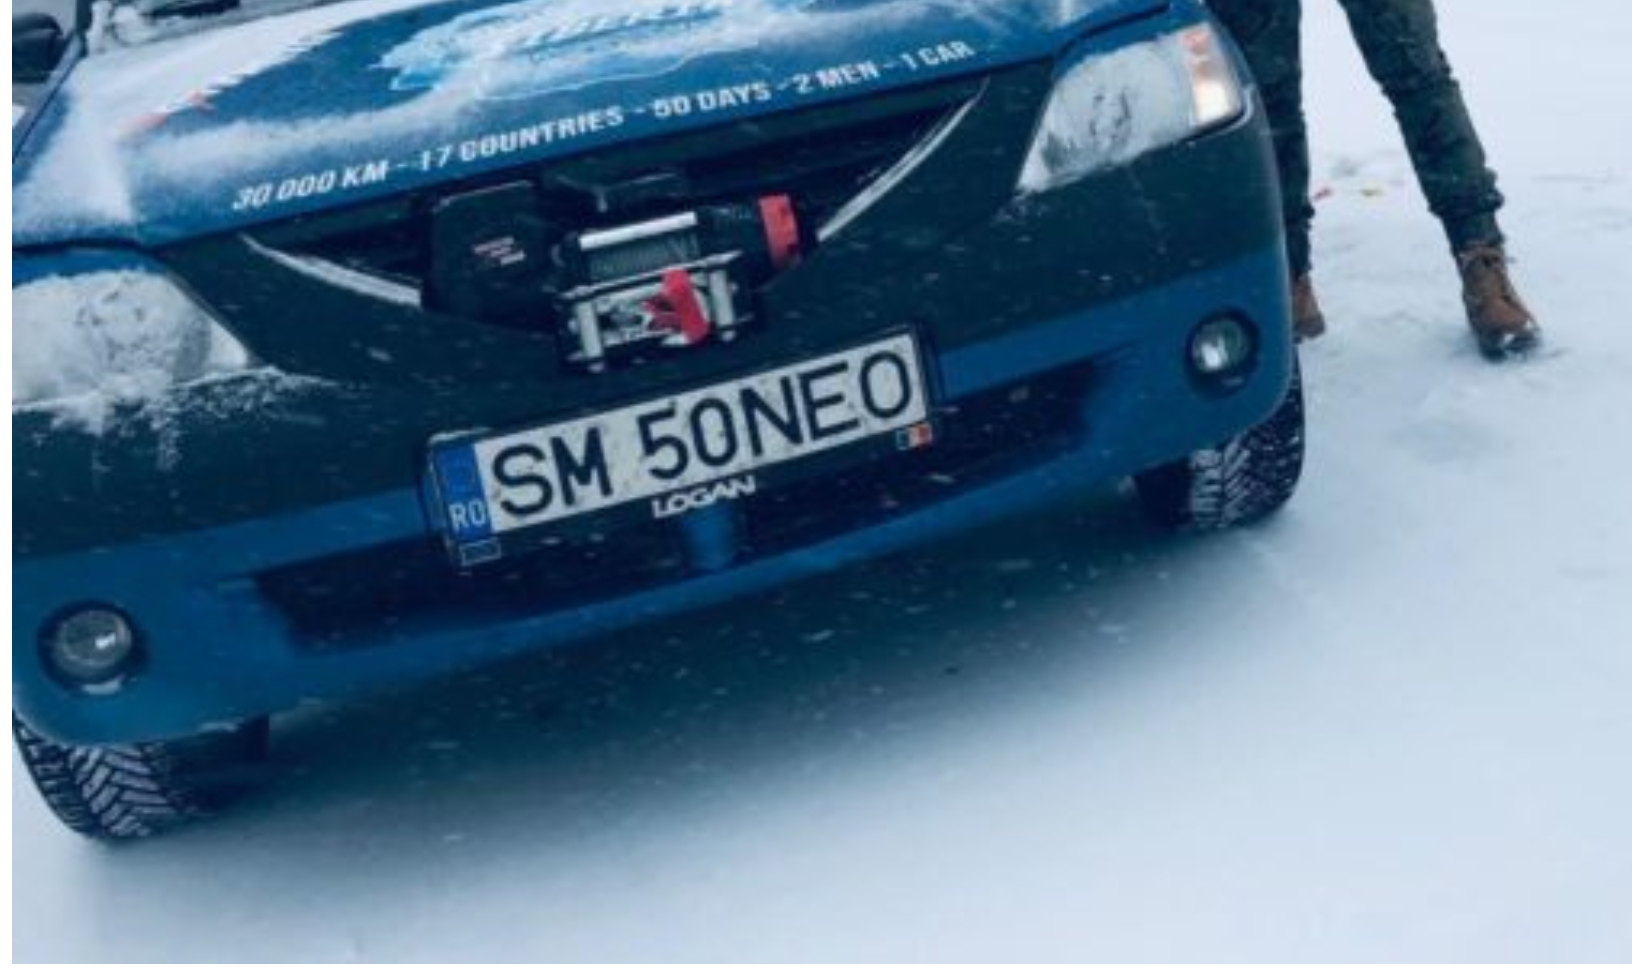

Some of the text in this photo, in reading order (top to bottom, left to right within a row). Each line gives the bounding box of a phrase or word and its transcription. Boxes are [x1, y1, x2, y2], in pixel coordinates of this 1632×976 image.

[232, 184, 272, 212] 30
[276, 174, 335, 203] 000
[342, 159, 388, 188] KM
[420, 144, 455, 172] 17
[460, 105, 625, 162] COUNTRIES
[654, 93, 692, 119] 50
[699, 81, 772, 112] DAYS
[790, 73, 814, 95] 2
[815, 60, 880, 90] MEN
[901, 51, 917, 71] 1
[918, 40, 976, 67] CAR
[492, 351, 912, 517] SM 50NEO
[448, 501, 488, 532] RO
[652, 474, 757, 519] LOGAN
